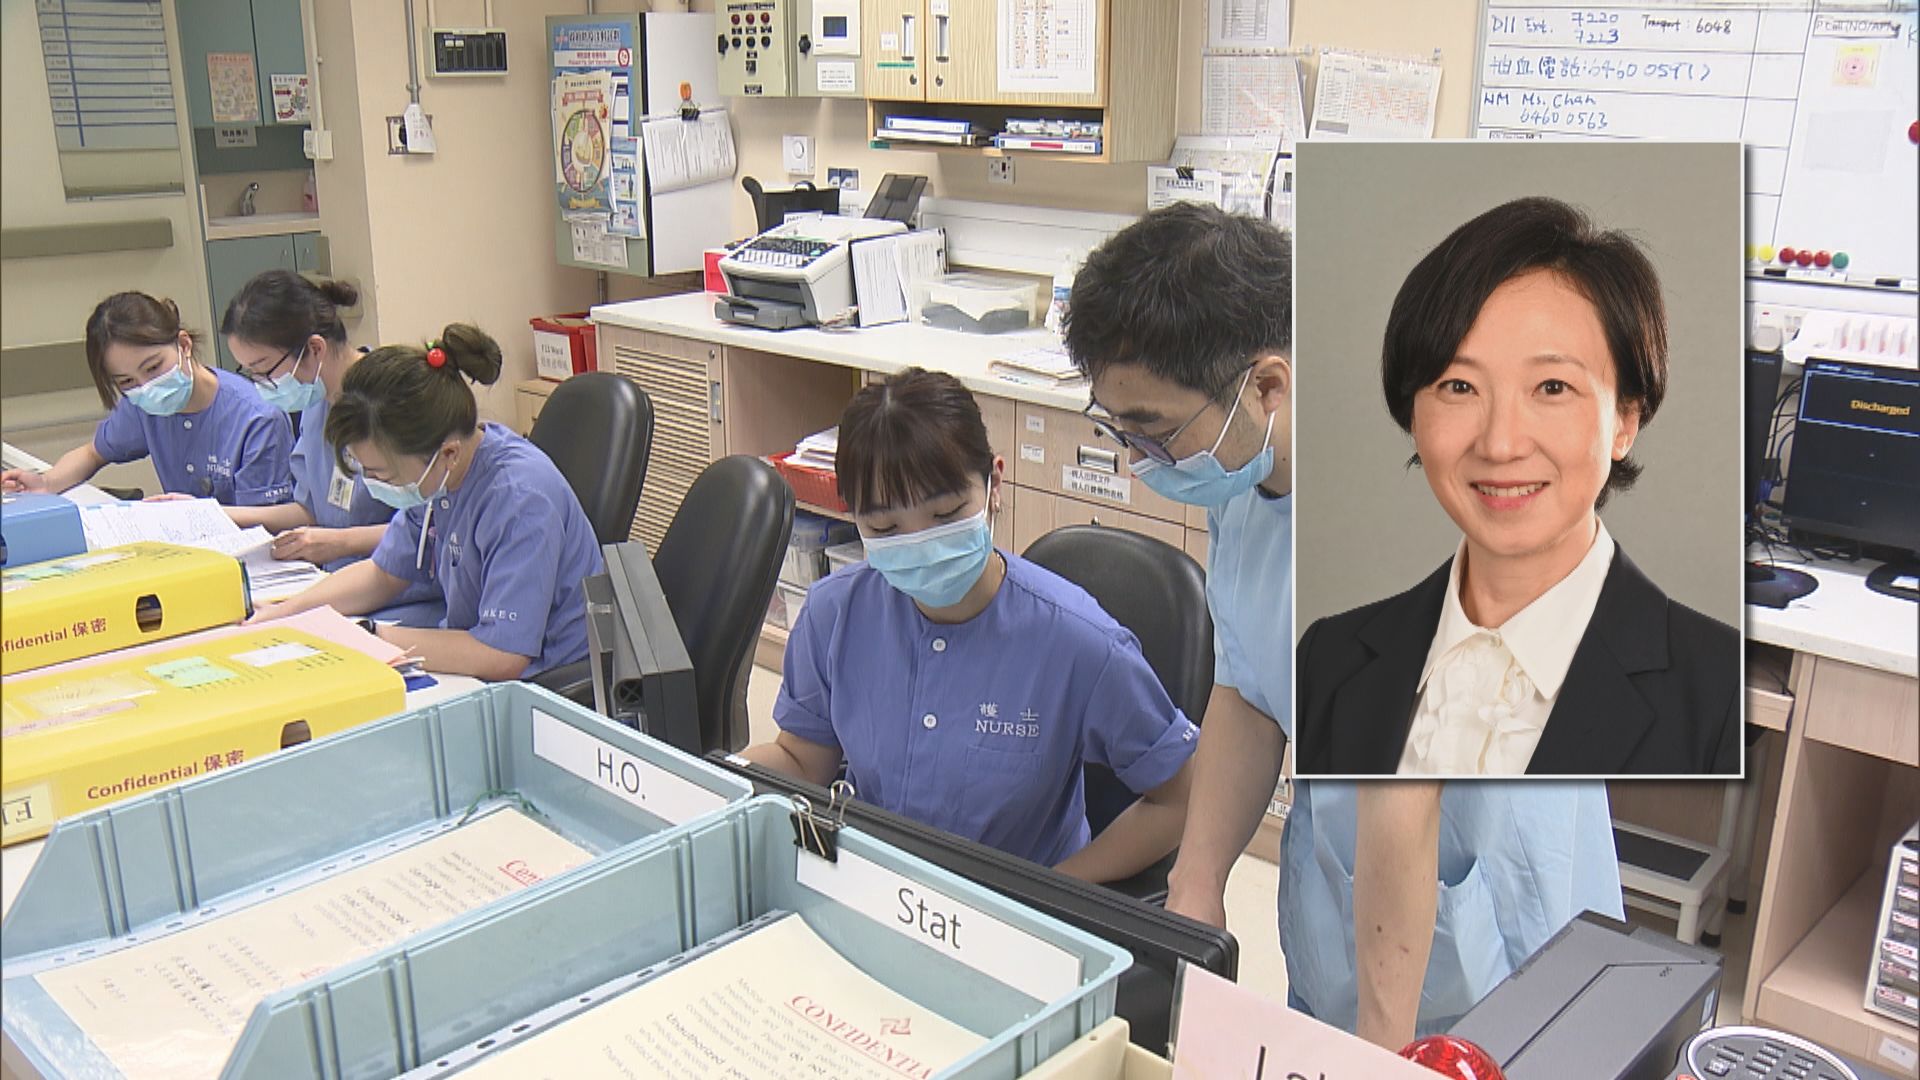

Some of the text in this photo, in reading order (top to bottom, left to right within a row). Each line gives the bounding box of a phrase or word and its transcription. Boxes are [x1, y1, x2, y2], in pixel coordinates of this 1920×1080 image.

[1571, 11, 1619, 26] 7220
[1695, 17, 1732, 34] 6048
[1552, 93, 1597, 109] Chan
[1850, 399, 1911, 416] Discharged
[72, 617, 107, 638] 保密
[975, 719, 1041, 738] NURSE
[87, 749, 245, 800] Confidential 保密
[596, 747, 647, 800] H.O.
[896, 887, 963, 950] Stat
